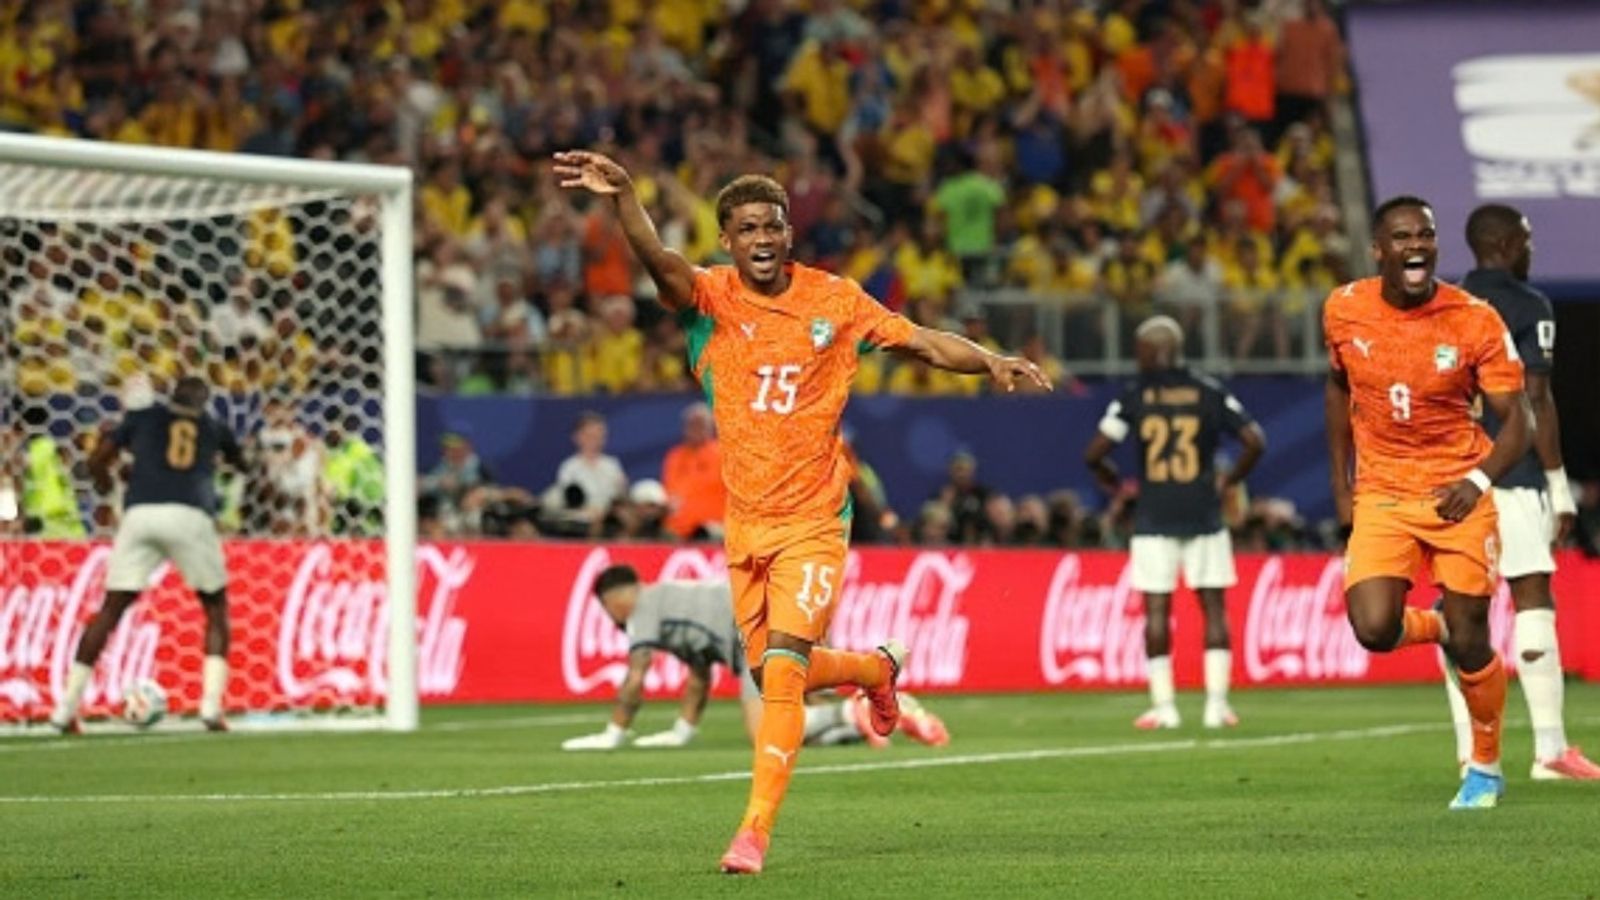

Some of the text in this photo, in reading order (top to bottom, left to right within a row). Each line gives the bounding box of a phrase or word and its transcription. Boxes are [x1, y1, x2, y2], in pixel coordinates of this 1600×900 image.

[750, 364, 801, 415] 15
[1389, 382, 1412, 422] 9
[166, 418, 198, 470] 6
[1140, 414, 1200, 484] 23
[795, 562, 835, 608] 15
[278, 543, 476, 698] Coca-Cla
